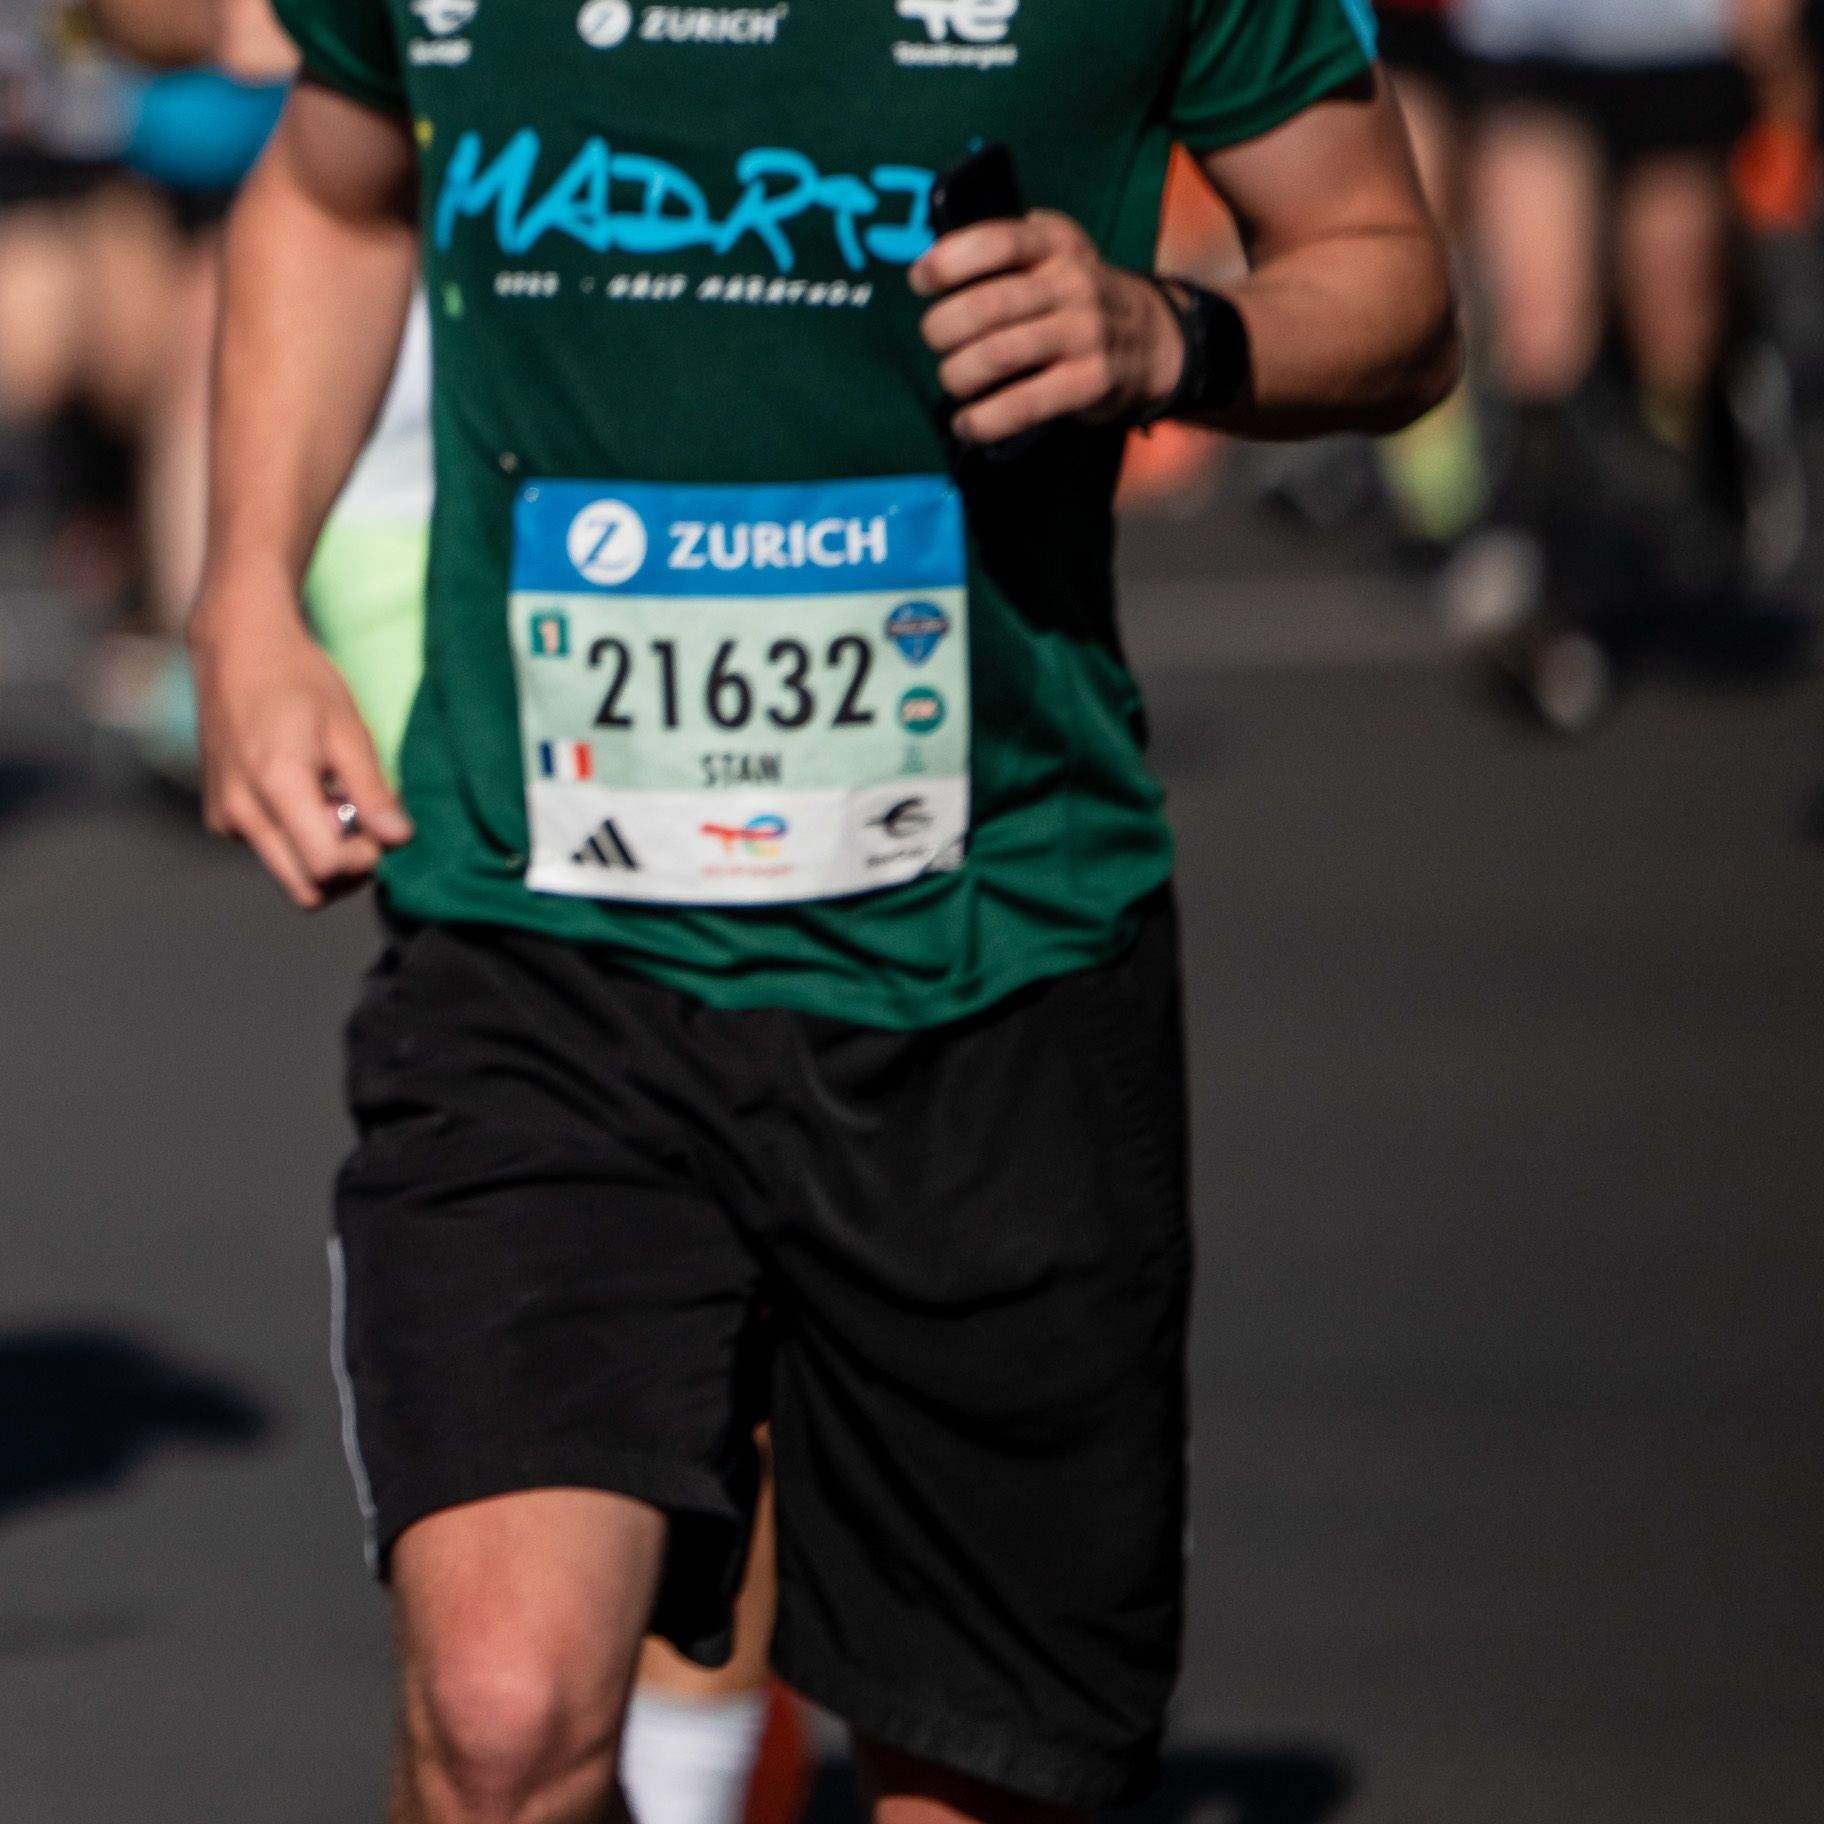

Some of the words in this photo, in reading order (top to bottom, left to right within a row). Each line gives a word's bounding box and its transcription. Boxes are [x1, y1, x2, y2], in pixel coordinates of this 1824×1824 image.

[640, 5, 779, 44] ZURICH
[669, 516, 888, 570] ZURICH
[588, 635, 878, 730] 21632
